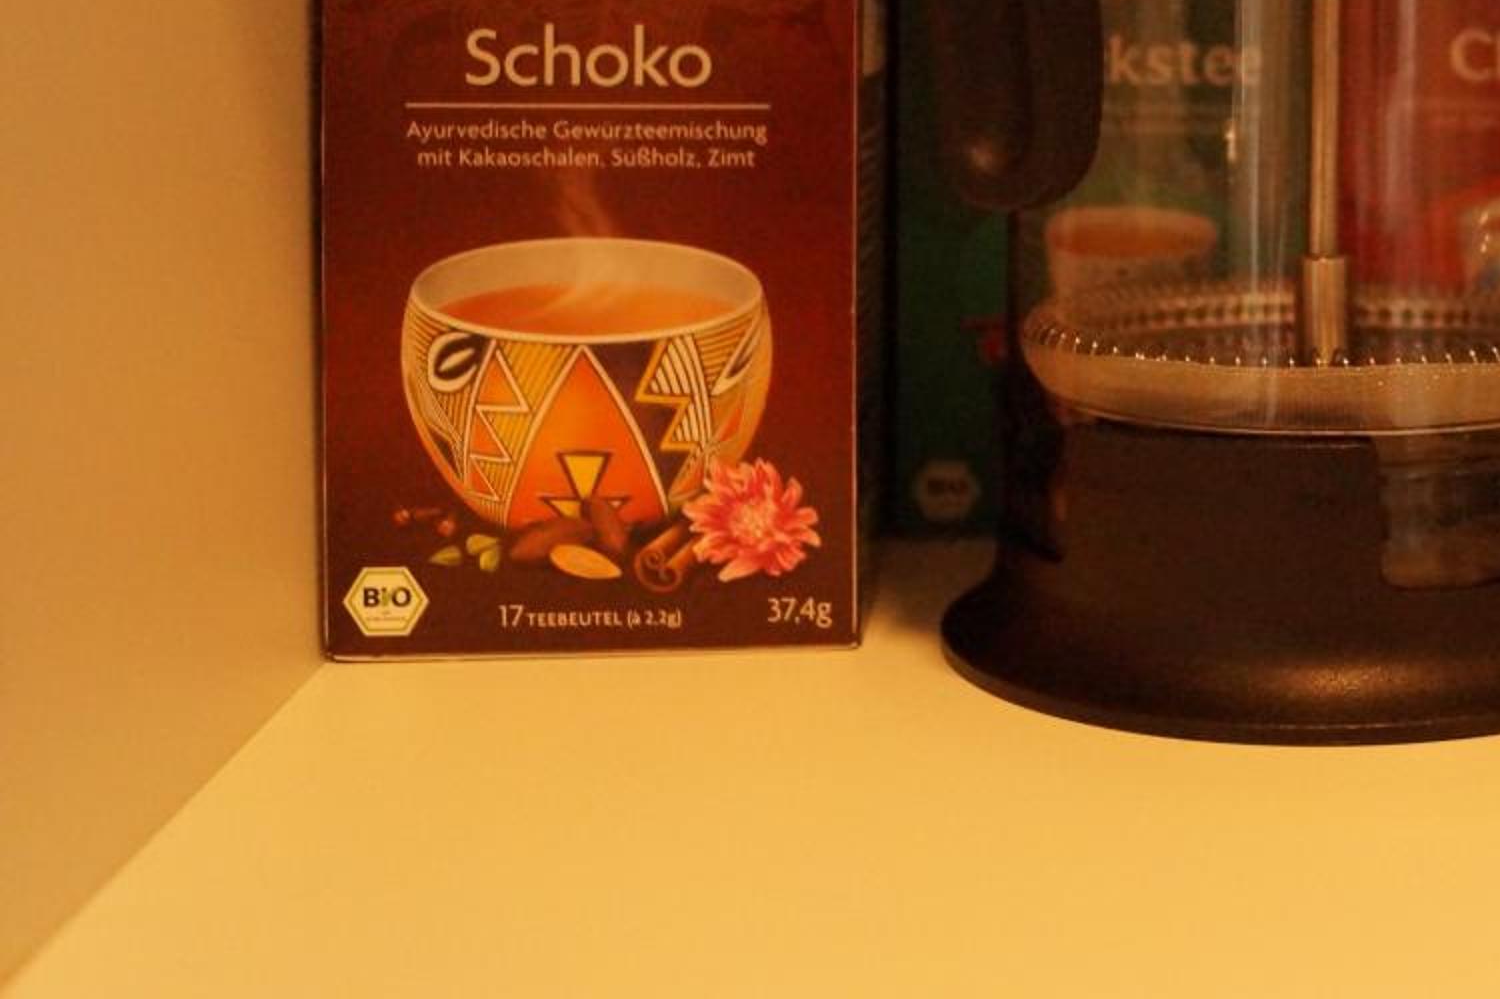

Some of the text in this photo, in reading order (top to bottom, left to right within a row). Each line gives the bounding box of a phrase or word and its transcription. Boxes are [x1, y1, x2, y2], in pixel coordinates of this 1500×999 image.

[465, 22, 712, 87] Schoko
[406, 118, 768, 145] Ayurvedische Gewürzteemischung
[417, 147, 452, 168] mit
[611, 147, 701, 168] Süßholz,
[708, 148, 755, 168] Zimt
[498, 604, 524, 628] 17
[527, 609, 623, 627] TEEBEUTEL
